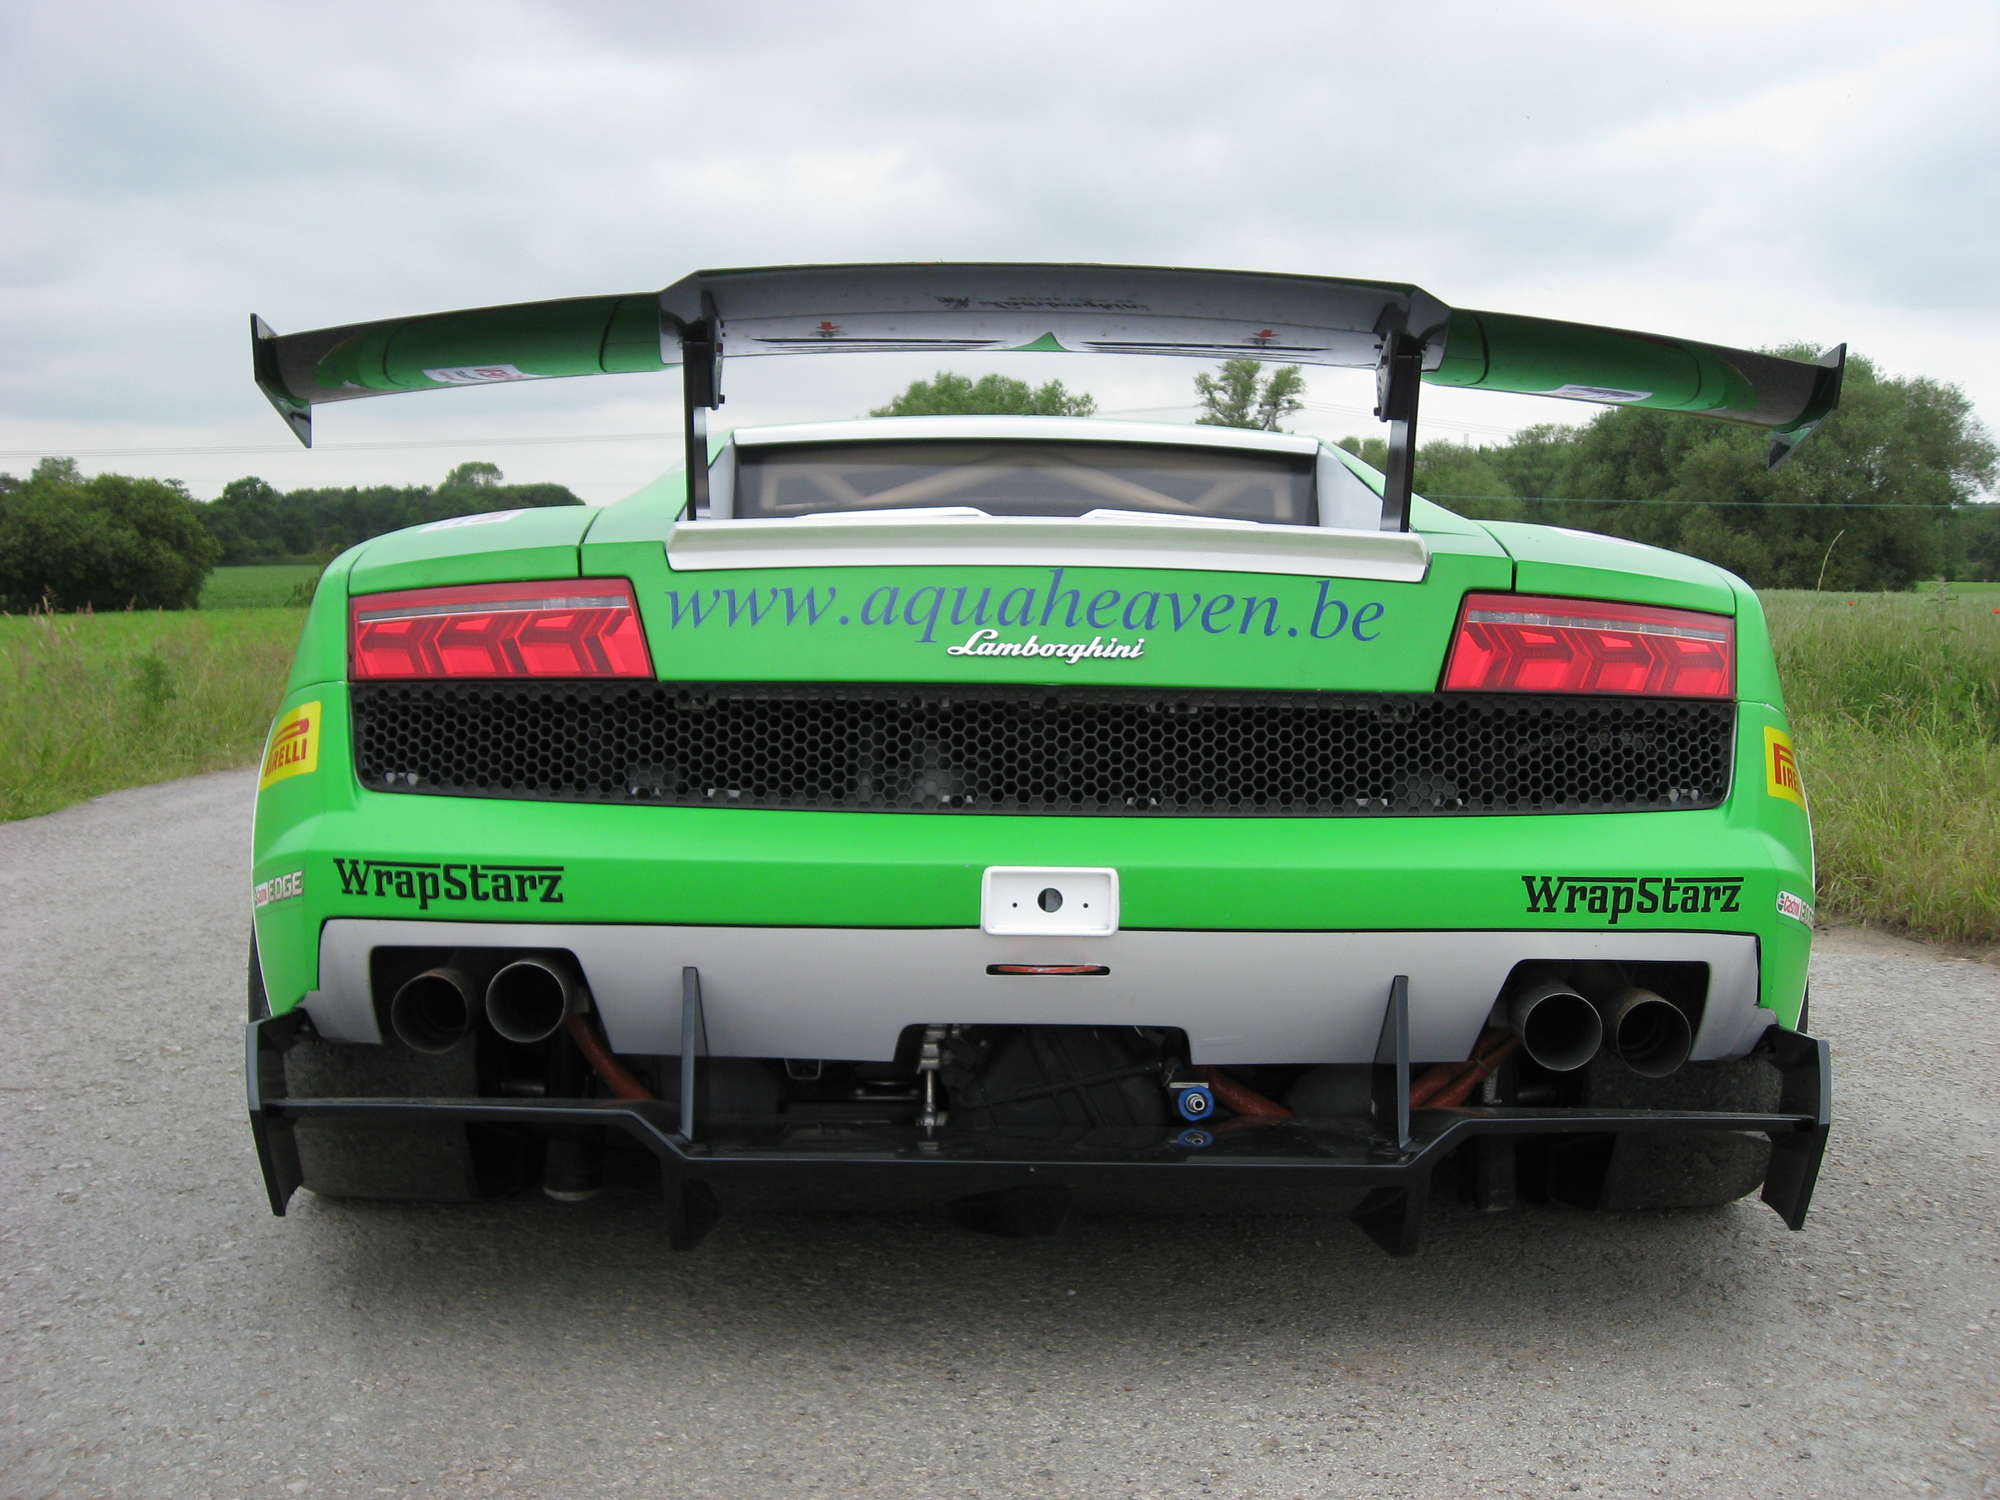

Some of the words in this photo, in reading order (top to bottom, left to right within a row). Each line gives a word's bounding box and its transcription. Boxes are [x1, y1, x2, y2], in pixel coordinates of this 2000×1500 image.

[666, 568, 1385, 642] www.aquaheaven.be
[947, 629, 1145, 664] Lamborghini
[268, 871, 304, 902] EDGE
[333, 858, 564, 910] WrapStarz
[1522, 876, 1744, 924] WrapStarz
